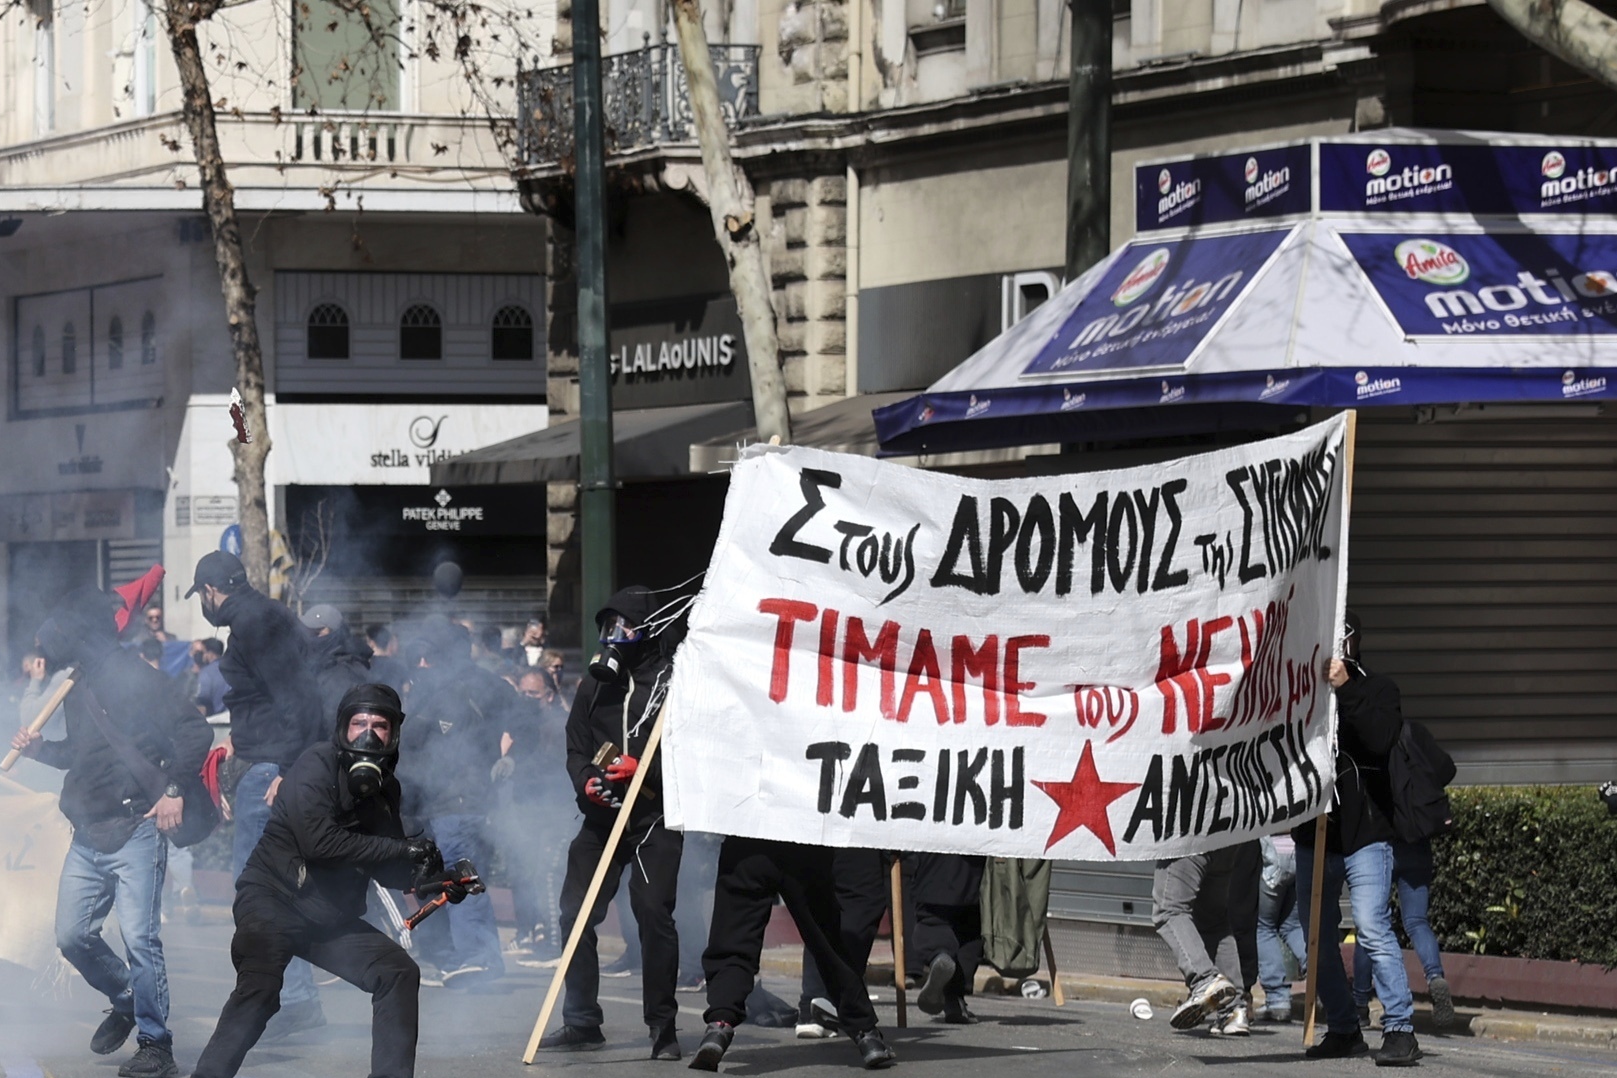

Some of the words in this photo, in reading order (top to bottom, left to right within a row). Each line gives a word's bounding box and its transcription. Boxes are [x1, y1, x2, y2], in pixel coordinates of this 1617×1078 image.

[1157, 177, 1202, 215] motion
[1245, 165, 1291, 205] motion
[1365, 163, 1453, 197] motion
[1403, 250, 1460, 278] Amita
[1068, 269, 1244, 350] motion
[1424, 267, 1617, 319] motio
[1441, 317, 1501, 335] Μόνο
[1503, 305, 1579, 330] θετική
[1357, 376, 1401, 396] motion
[1561, 376, 1606, 396] motion
[370, 448, 410, 468] stella
[402, 507, 435, 521] PATEK
[437, 507, 484, 521] PHILIPPE
[929, 478, 1189, 597] ΔΡΟΜΟΥΣ
[757, 598, 1052, 729] ΤΙΜΑΜΕ
[805, 741, 1026, 830] ΤΑΞΙΚΗ
